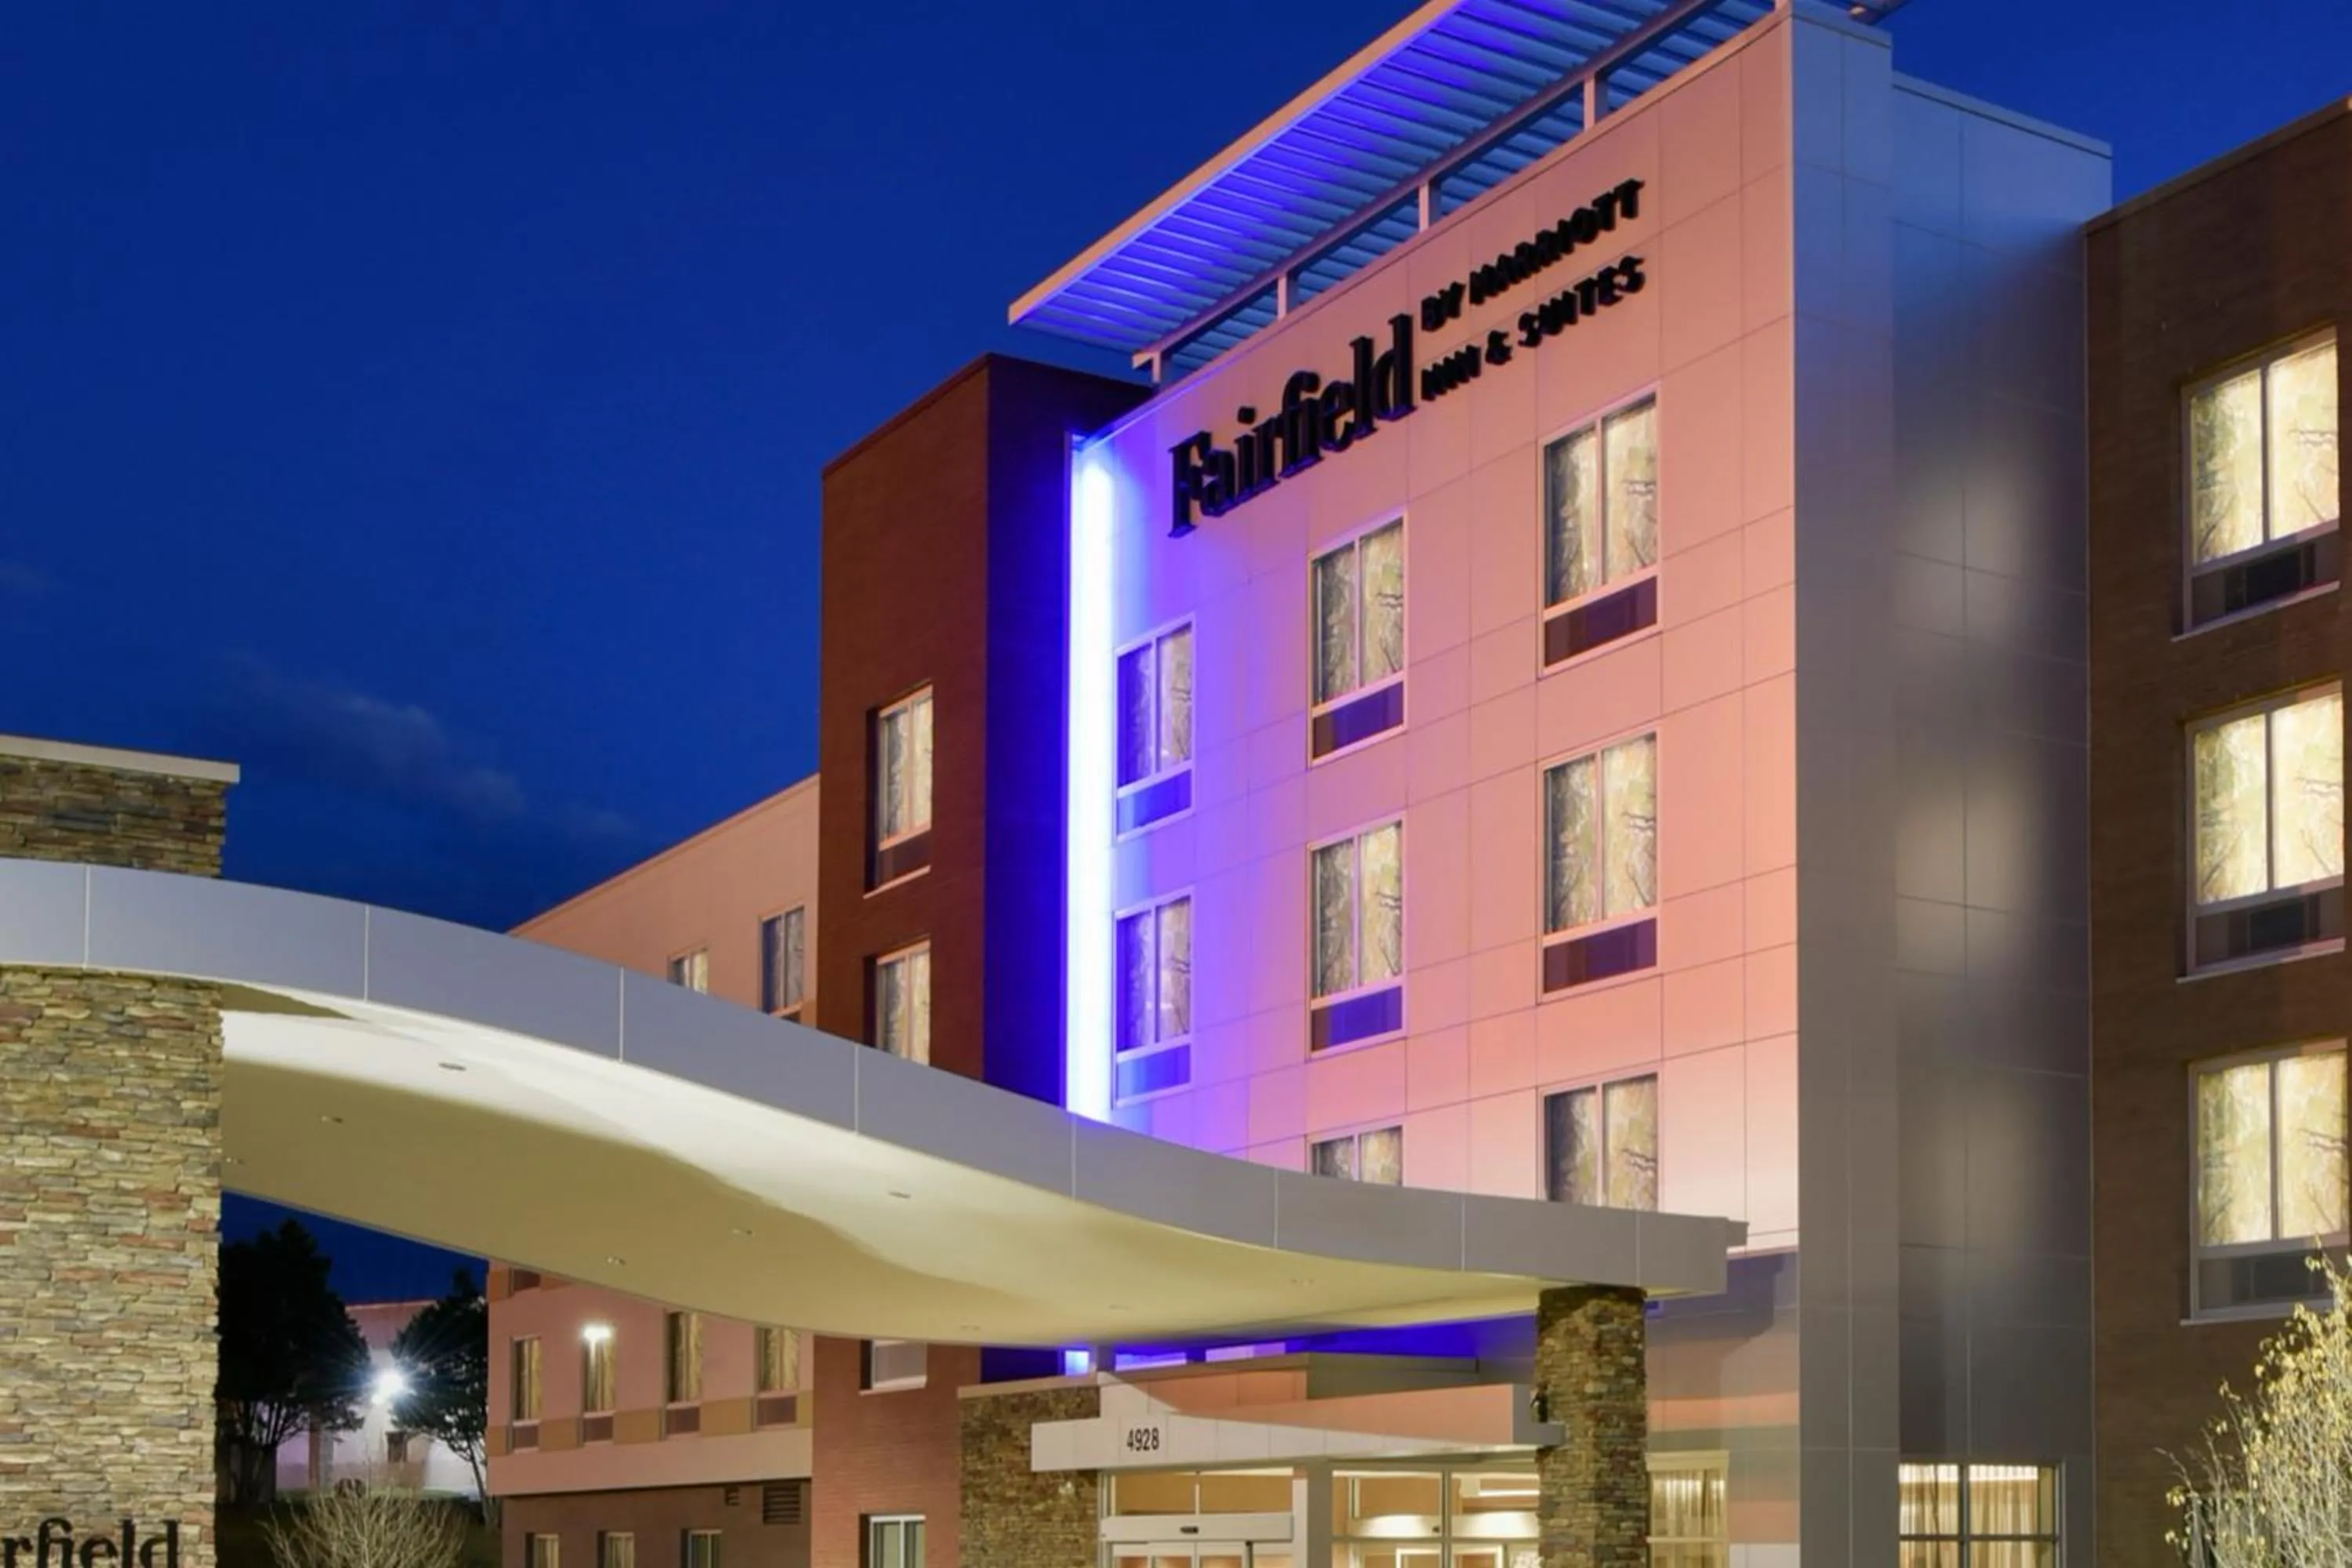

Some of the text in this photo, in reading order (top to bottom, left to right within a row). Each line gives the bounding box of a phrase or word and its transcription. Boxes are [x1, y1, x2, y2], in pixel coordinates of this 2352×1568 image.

[1421, 178, 1645, 332] BY MARRIOTT
[1485, 330, 1513, 365] &
[1518, 256, 1645, 347] SUITES
[1169, 313, 1417, 537] Fairfield
[1127, 1427, 1160, 1451] 4928
